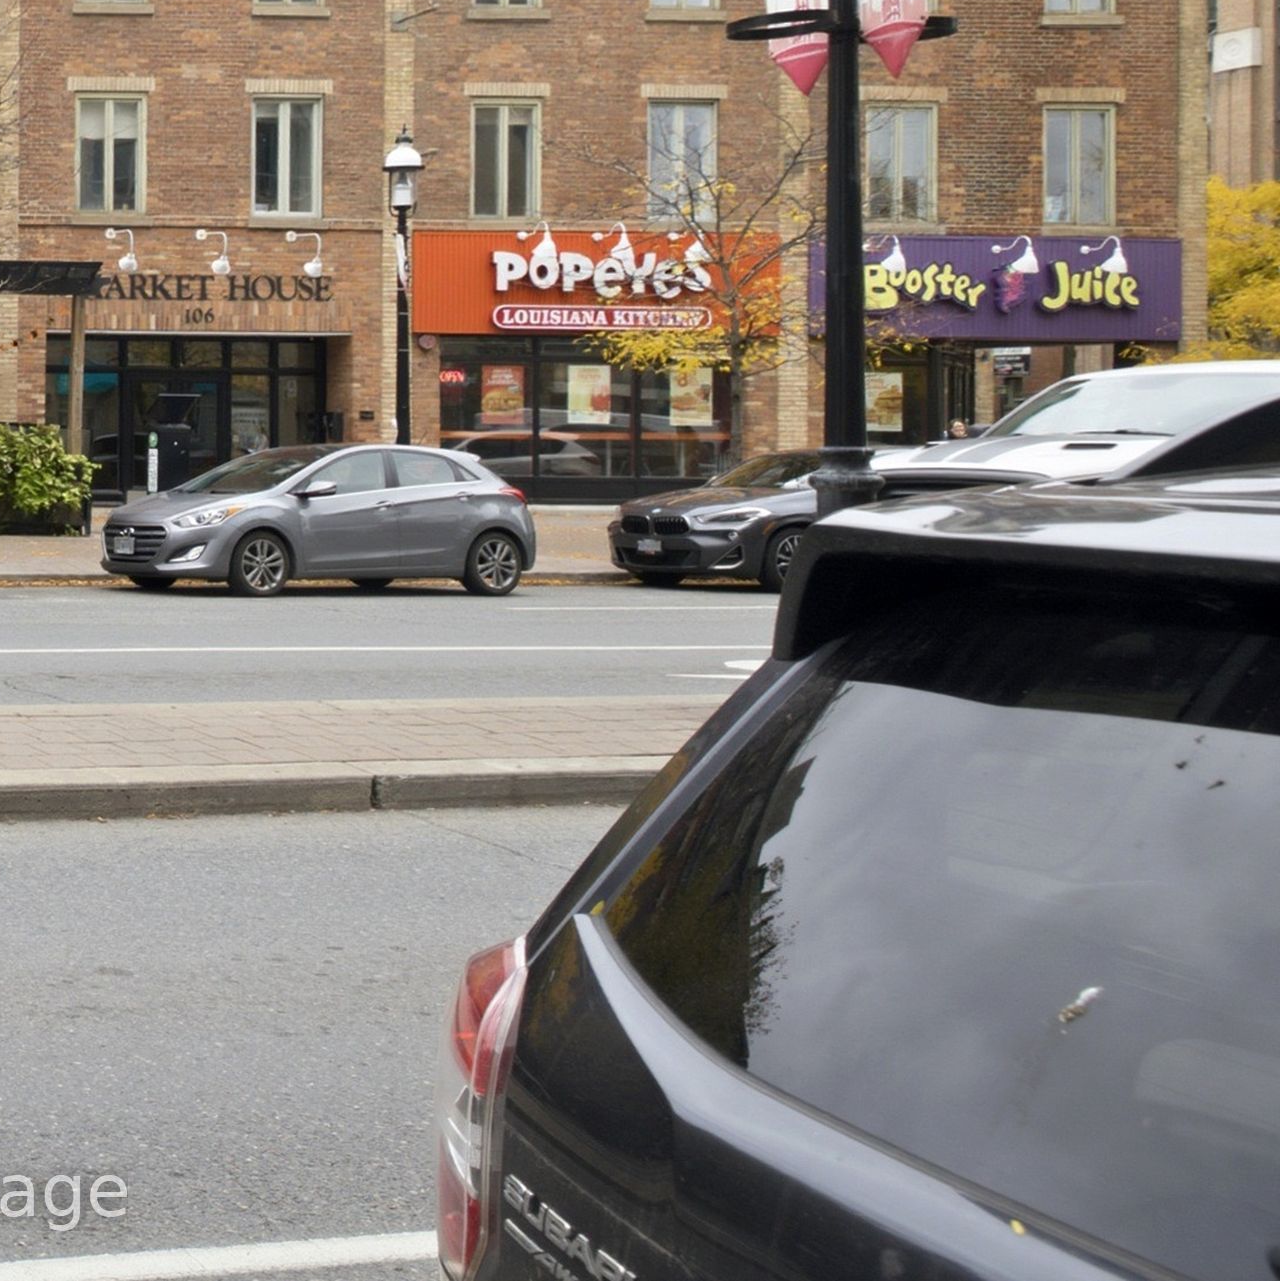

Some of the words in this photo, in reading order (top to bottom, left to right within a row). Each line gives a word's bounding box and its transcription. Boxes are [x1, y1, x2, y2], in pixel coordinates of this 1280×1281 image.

[90, 273, 216, 301] ARKET
[226, 274, 333, 302] HOUSE
[864, 261, 986, 311] Booster
[1042, 261, 1140, 310] Juice
[184, 307, 215, 324] 106
[502, 309, 609, 326] LOUISIANA
[504, 1173, 638, 1281] SUBAR
